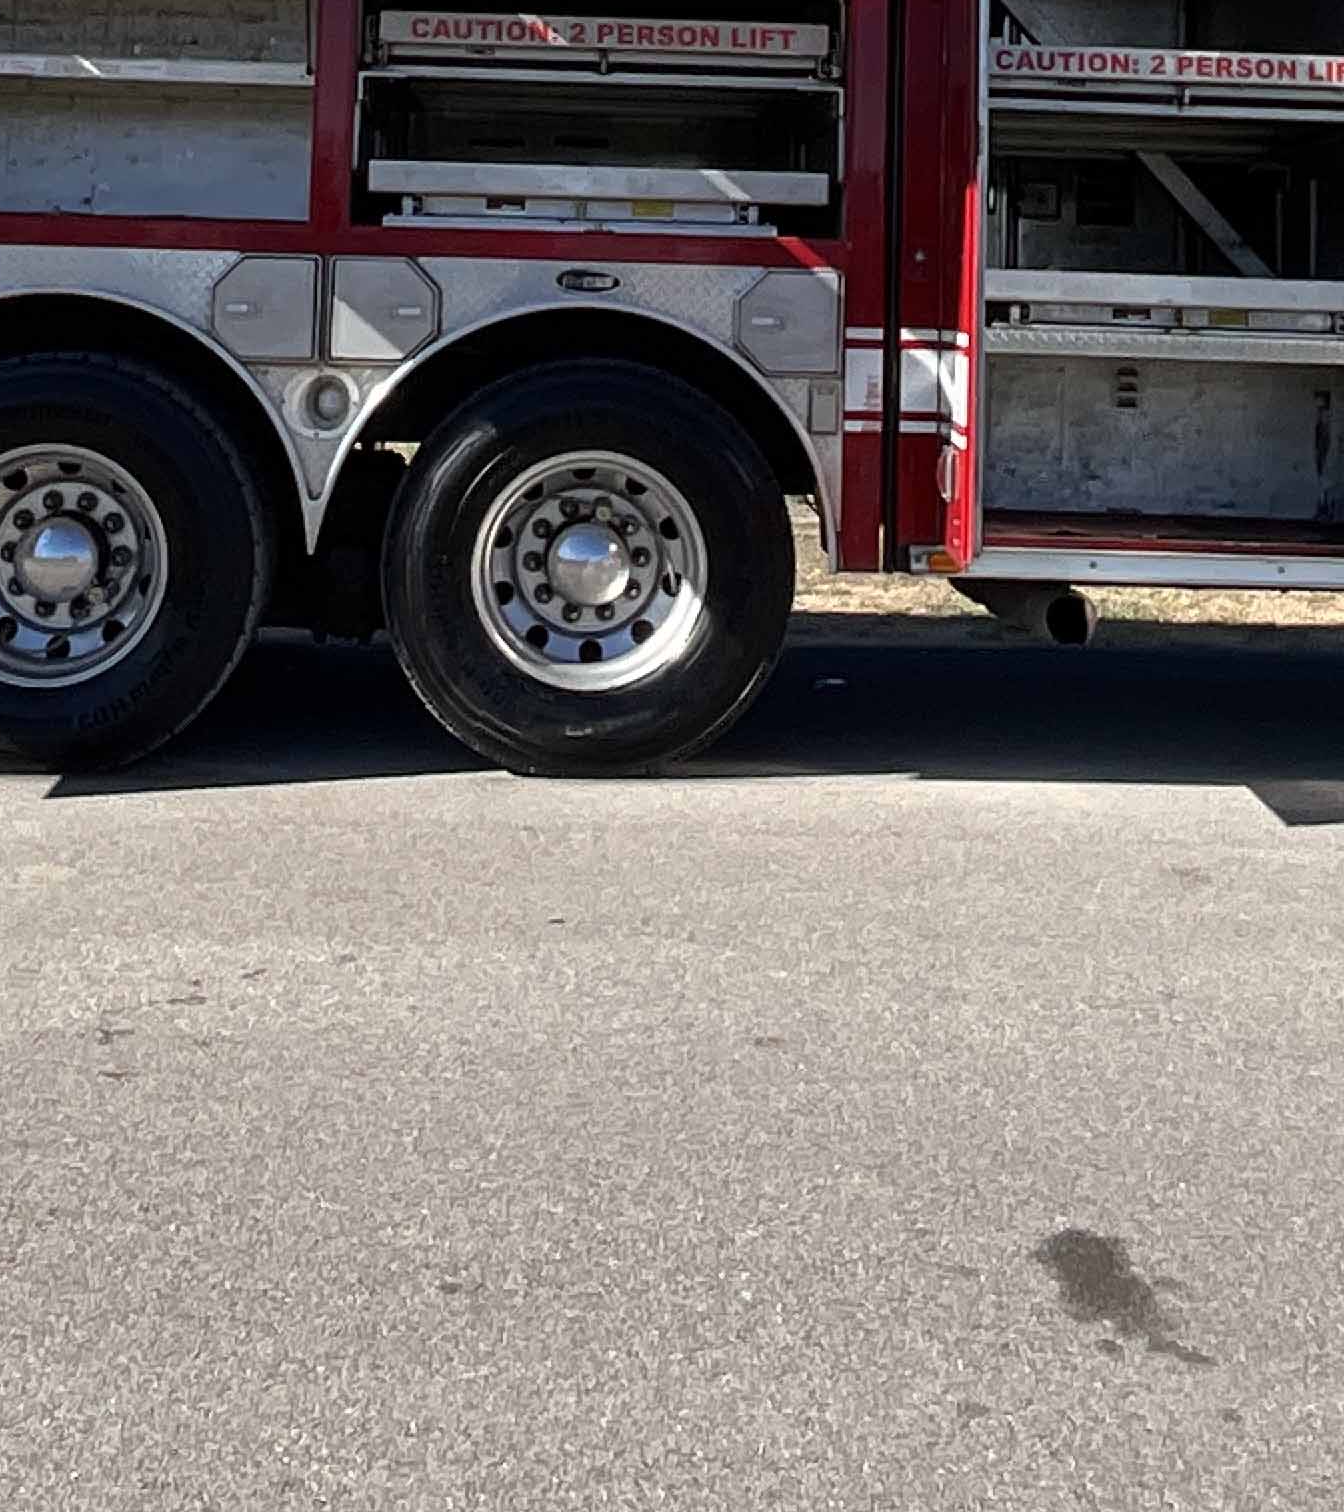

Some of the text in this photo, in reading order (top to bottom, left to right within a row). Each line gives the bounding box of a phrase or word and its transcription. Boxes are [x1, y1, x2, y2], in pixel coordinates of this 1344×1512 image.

[411, 17, 799, 50] CAUTION: 2 PERSON LIFT
[995, 49, 1140, 73] CAUTION:
[1149, 55, 1167, 75] 2
[1175, 56, 1297, 80] PERSON
